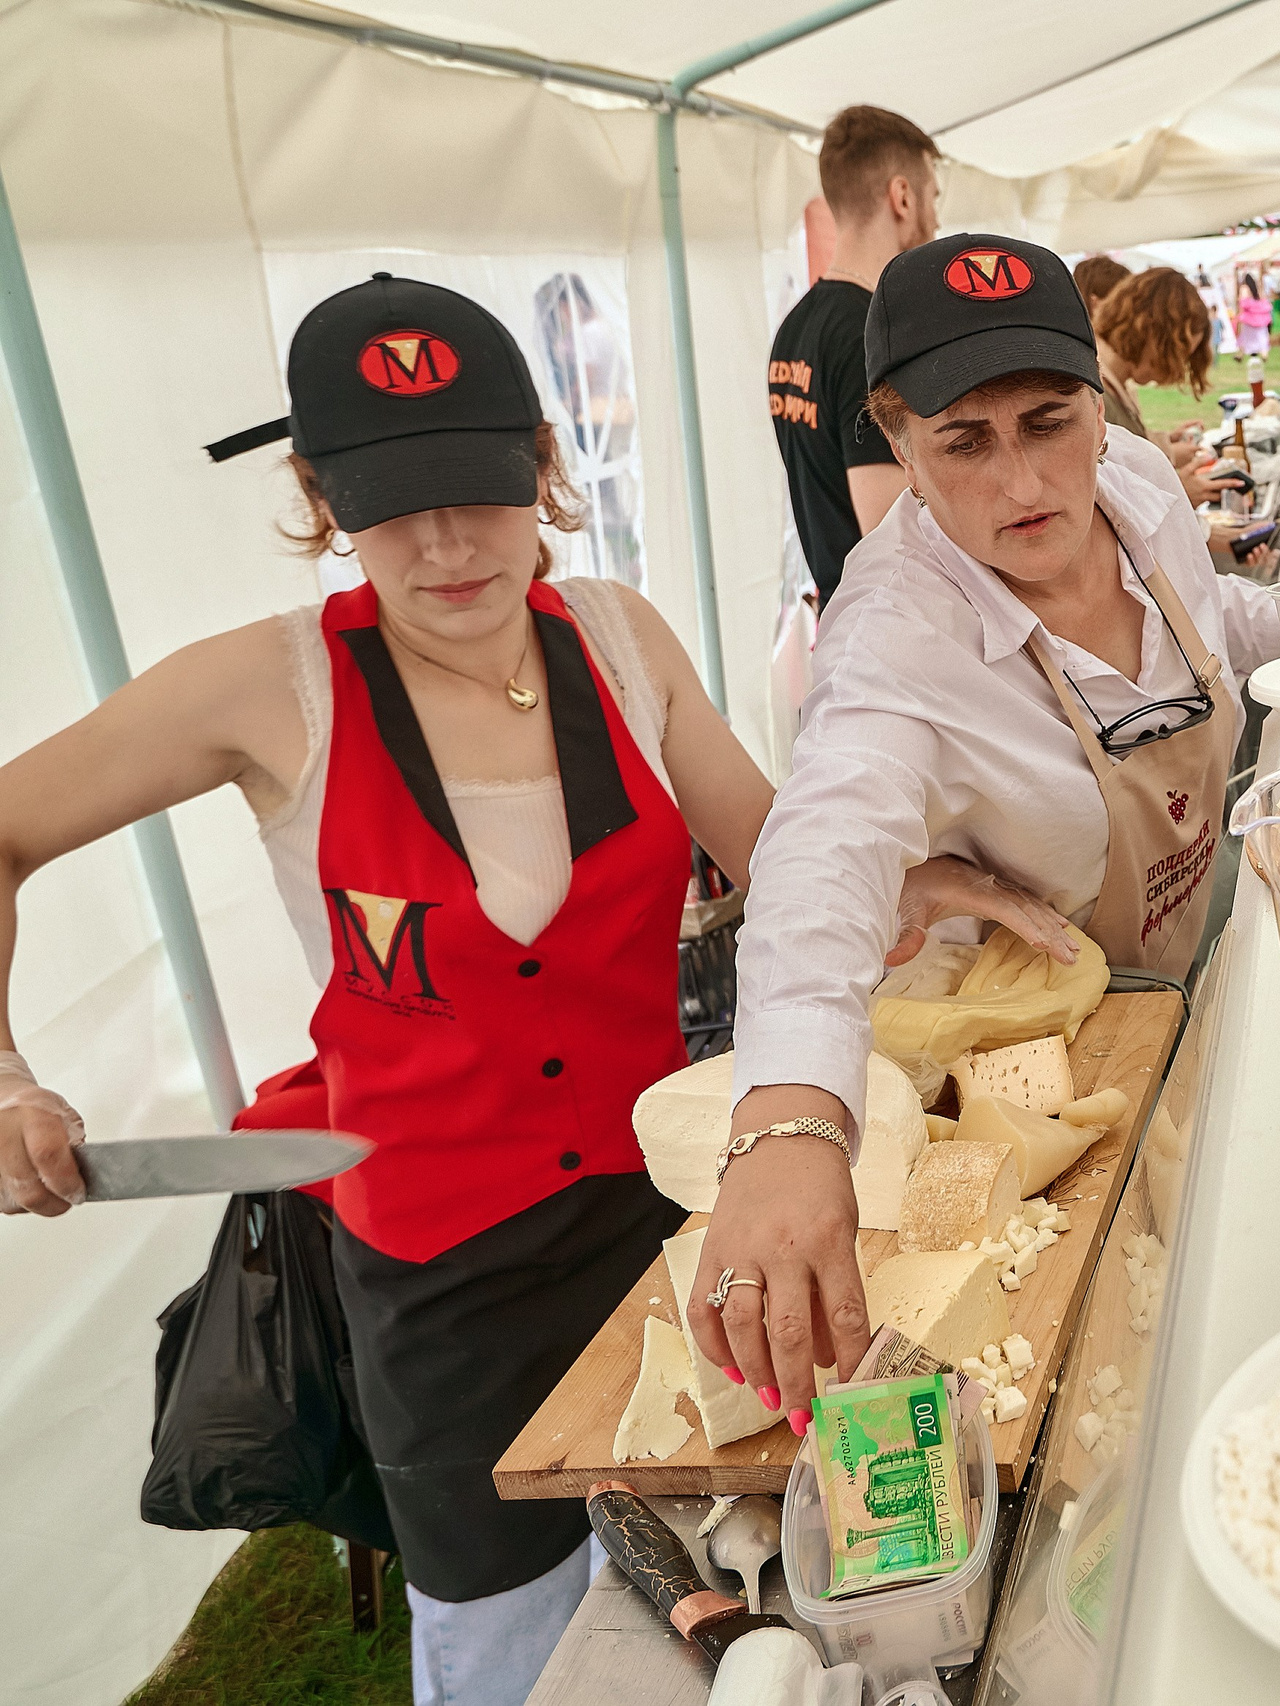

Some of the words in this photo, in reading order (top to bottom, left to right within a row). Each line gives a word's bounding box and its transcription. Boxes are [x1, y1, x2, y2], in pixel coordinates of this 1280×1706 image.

[914, 1402, 937, 1438] 200
[925, 1449, 949, 1507] РУБЛЕЙ
[939, 1513, 954, 1560] ВЕСТИ
